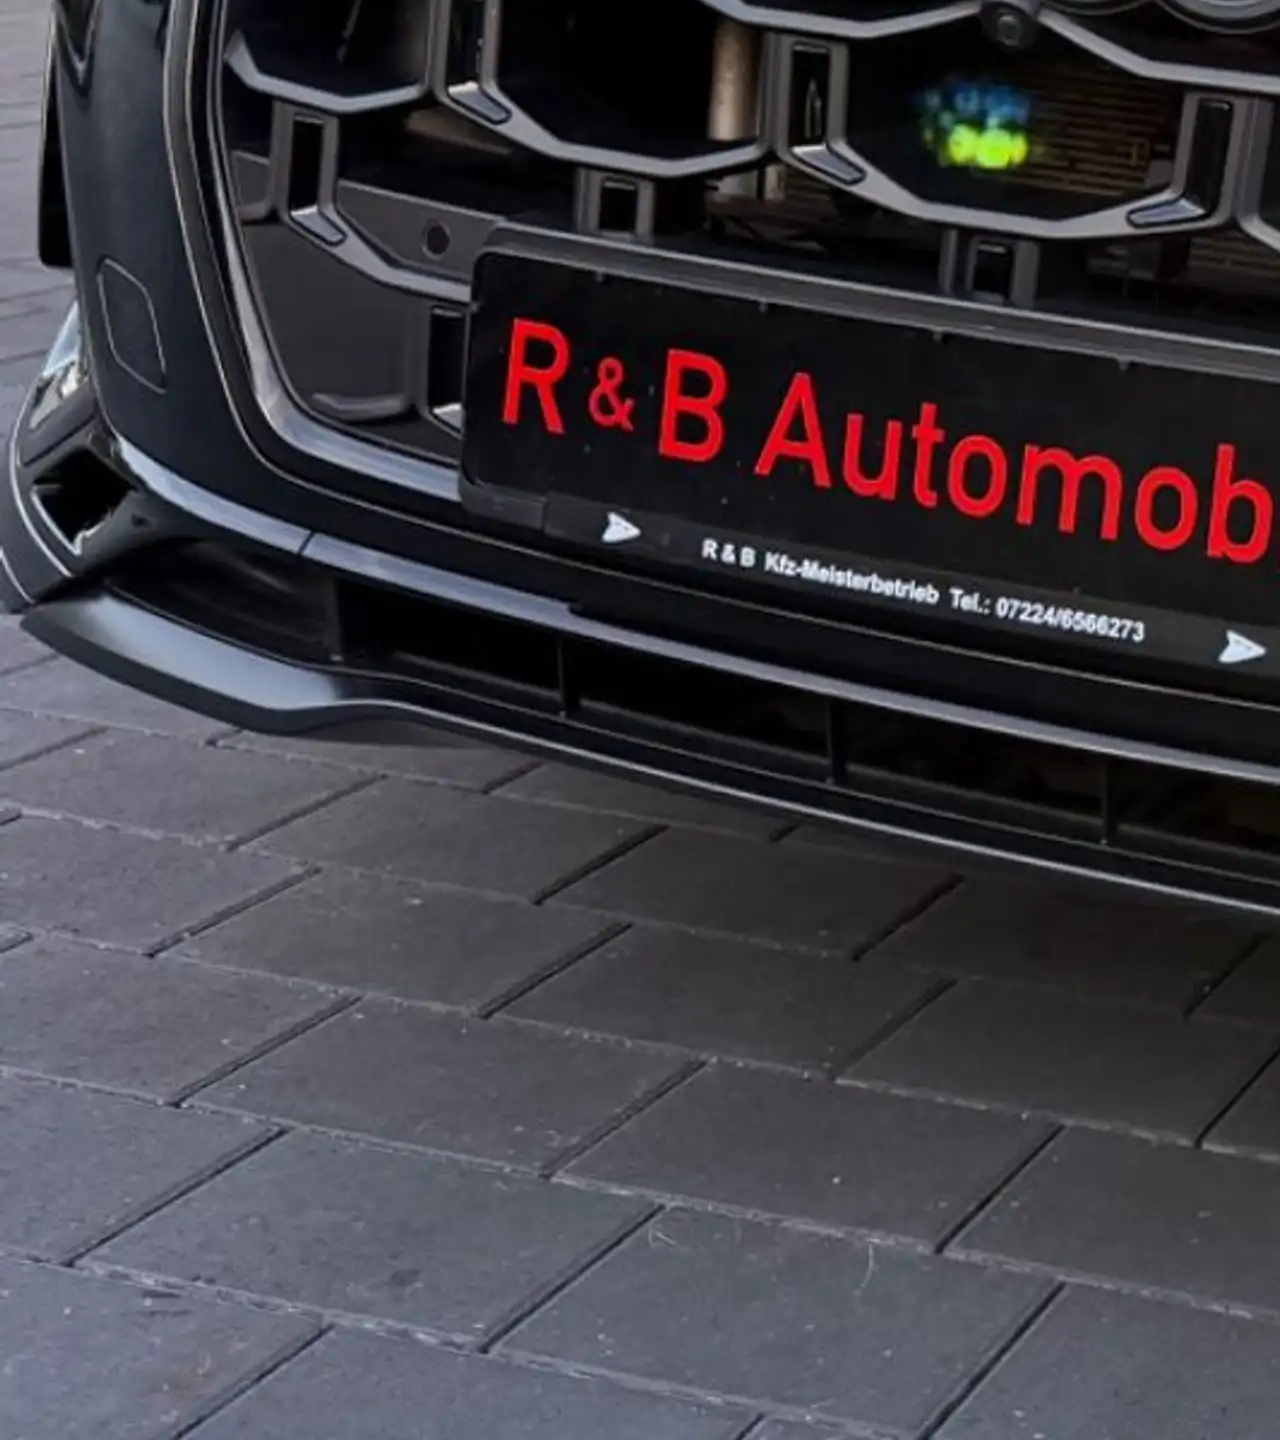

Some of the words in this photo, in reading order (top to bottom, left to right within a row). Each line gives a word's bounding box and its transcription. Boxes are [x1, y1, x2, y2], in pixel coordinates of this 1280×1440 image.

[502, 318, 570, 433] R
[588, 357, 634, 432] &
[658, 348, 729, 462] B
[701, 537, 719, 560] R
[720, 543, 736, 564] &
[739, 546, 757, 568] B
[764, 550, 940, 605] Kfz-Meisterbetrieb
[949, 586, 991, 615] Tel.:
